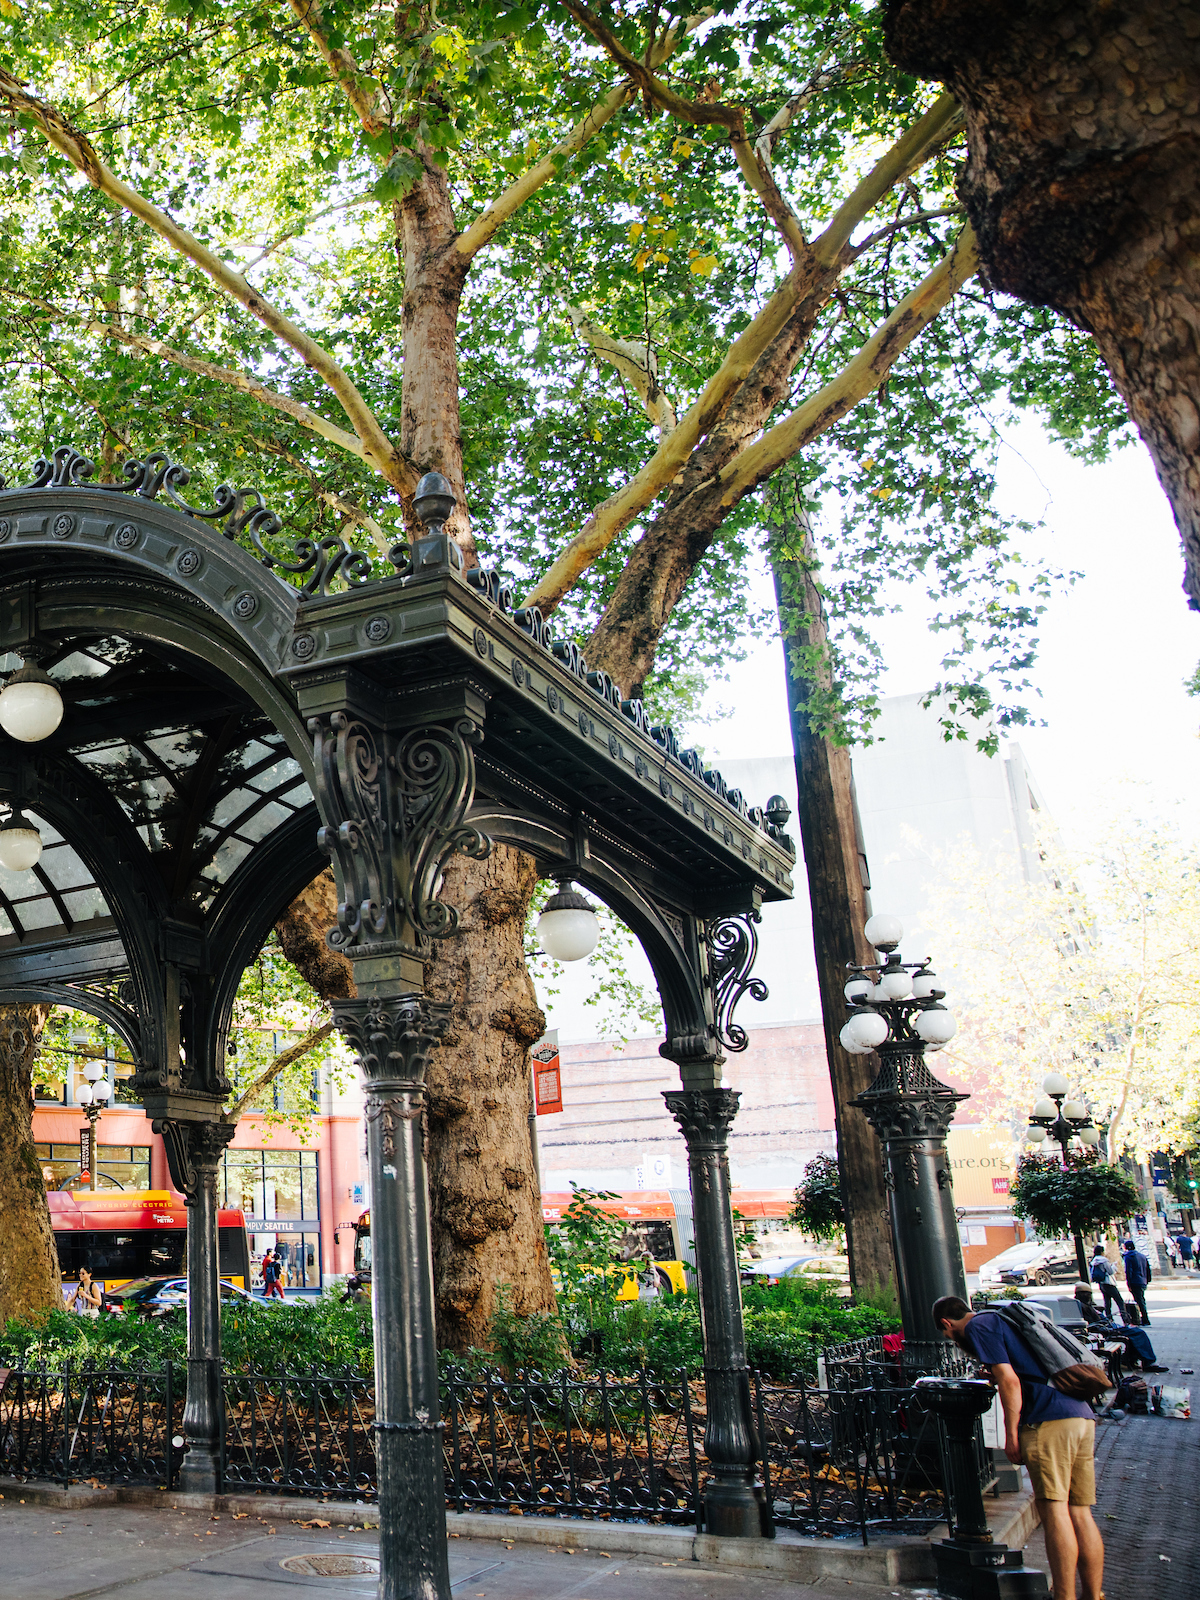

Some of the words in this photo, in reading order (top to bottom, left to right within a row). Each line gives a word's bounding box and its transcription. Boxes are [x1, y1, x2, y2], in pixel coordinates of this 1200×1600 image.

[949, 1157, 1010, 1171] are.org
[245, 1222, 264, 1230] MPLY
[264, 1222, 294, 1230] SEATTLE
